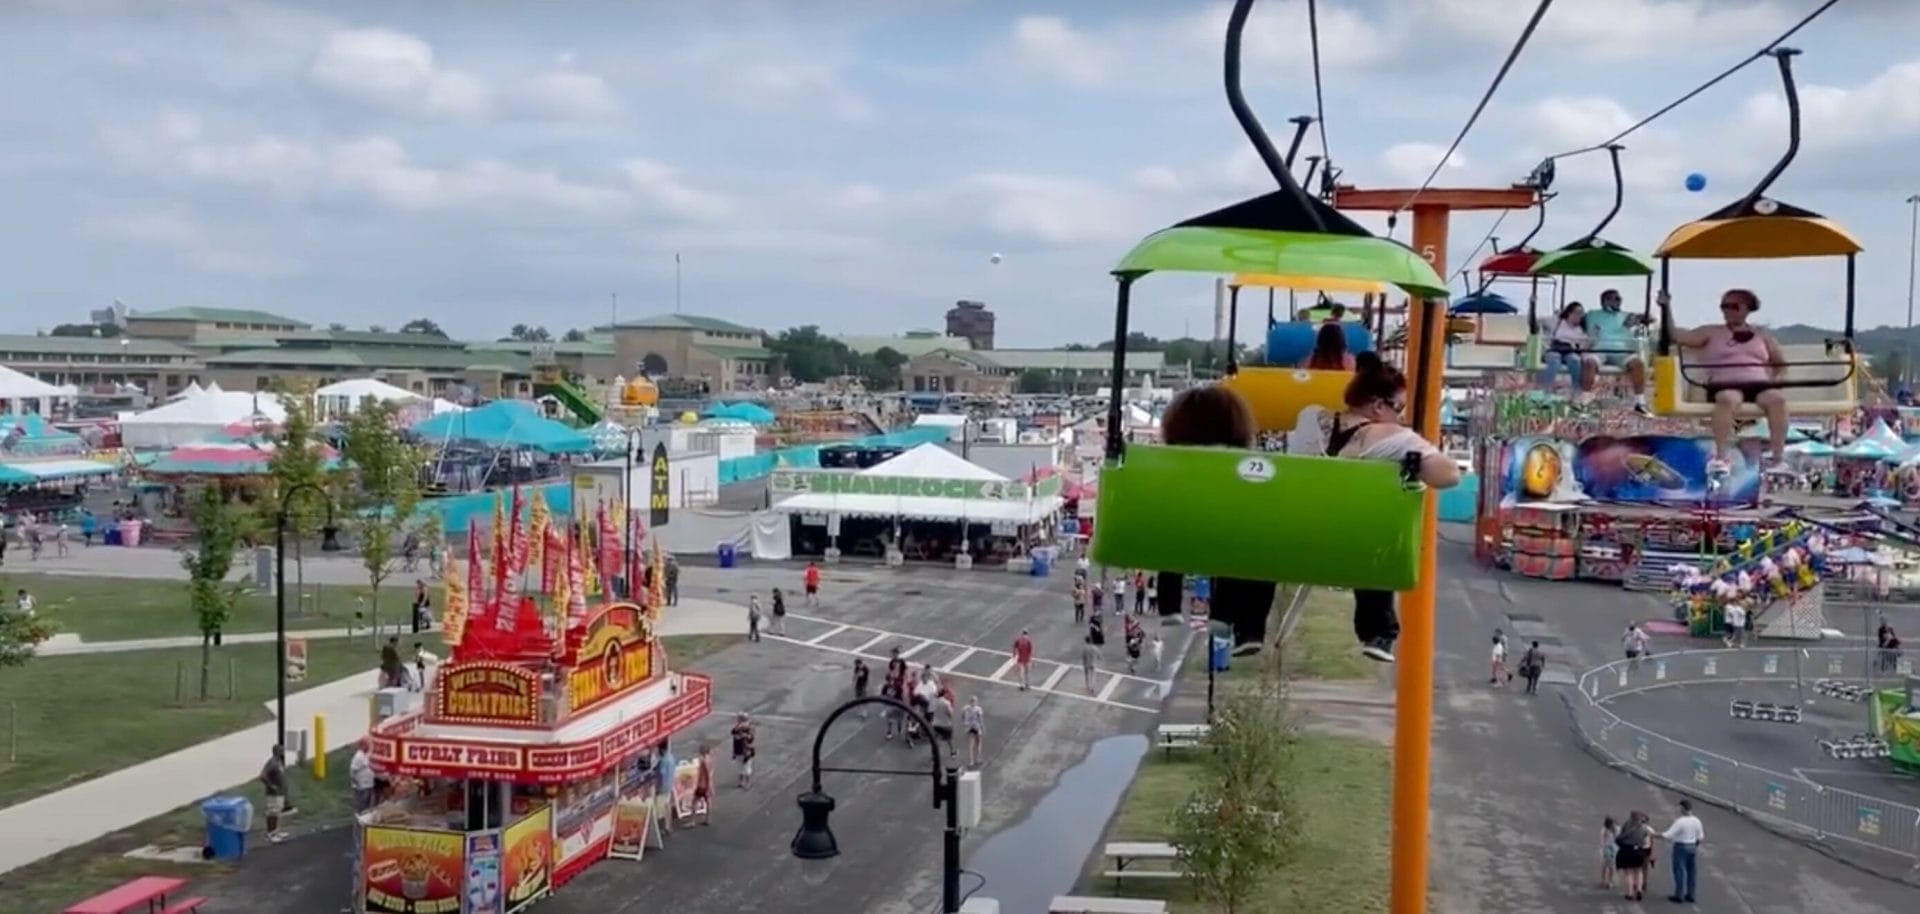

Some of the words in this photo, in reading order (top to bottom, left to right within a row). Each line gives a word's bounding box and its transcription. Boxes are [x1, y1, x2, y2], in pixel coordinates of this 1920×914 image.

[1249, 461, 1264, 473] 73
[652, 457, 668, 509] ATM
[809, 473, 983, 499] SHAMROCK
[451, 670, 486, 690] WILD
[449, 691, 489, 714] CURLY
[490, 693, 529, 716] FRIES
[408, 744, 463, 763] CURLY
[466, 748, 517, 767] FRIES
